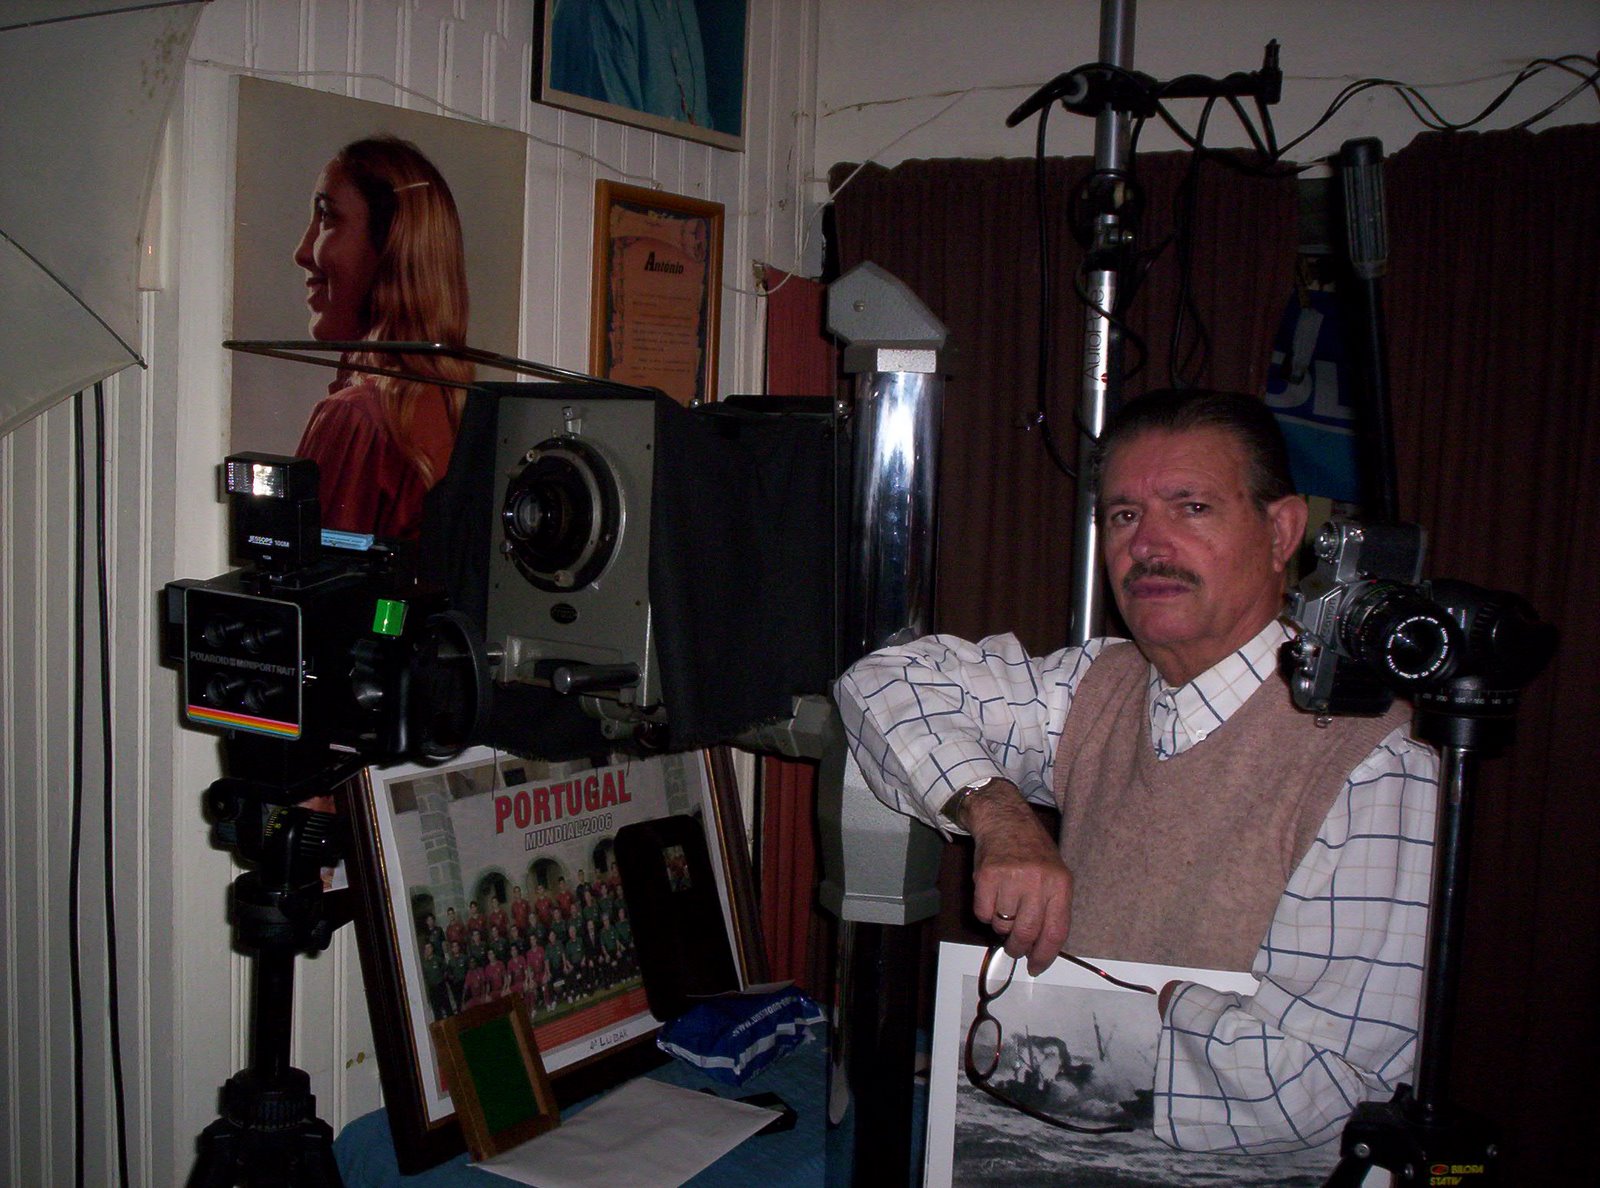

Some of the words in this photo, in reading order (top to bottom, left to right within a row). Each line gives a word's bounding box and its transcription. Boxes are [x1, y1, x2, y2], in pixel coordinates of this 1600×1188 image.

[1084, 289, 1104, 381] AutoPe
[190, 651, 229, 666] POLAROID
[494, 770, 632, 834] PORTUGAL
[1429, 1176, 1463, 1187] STATIV
